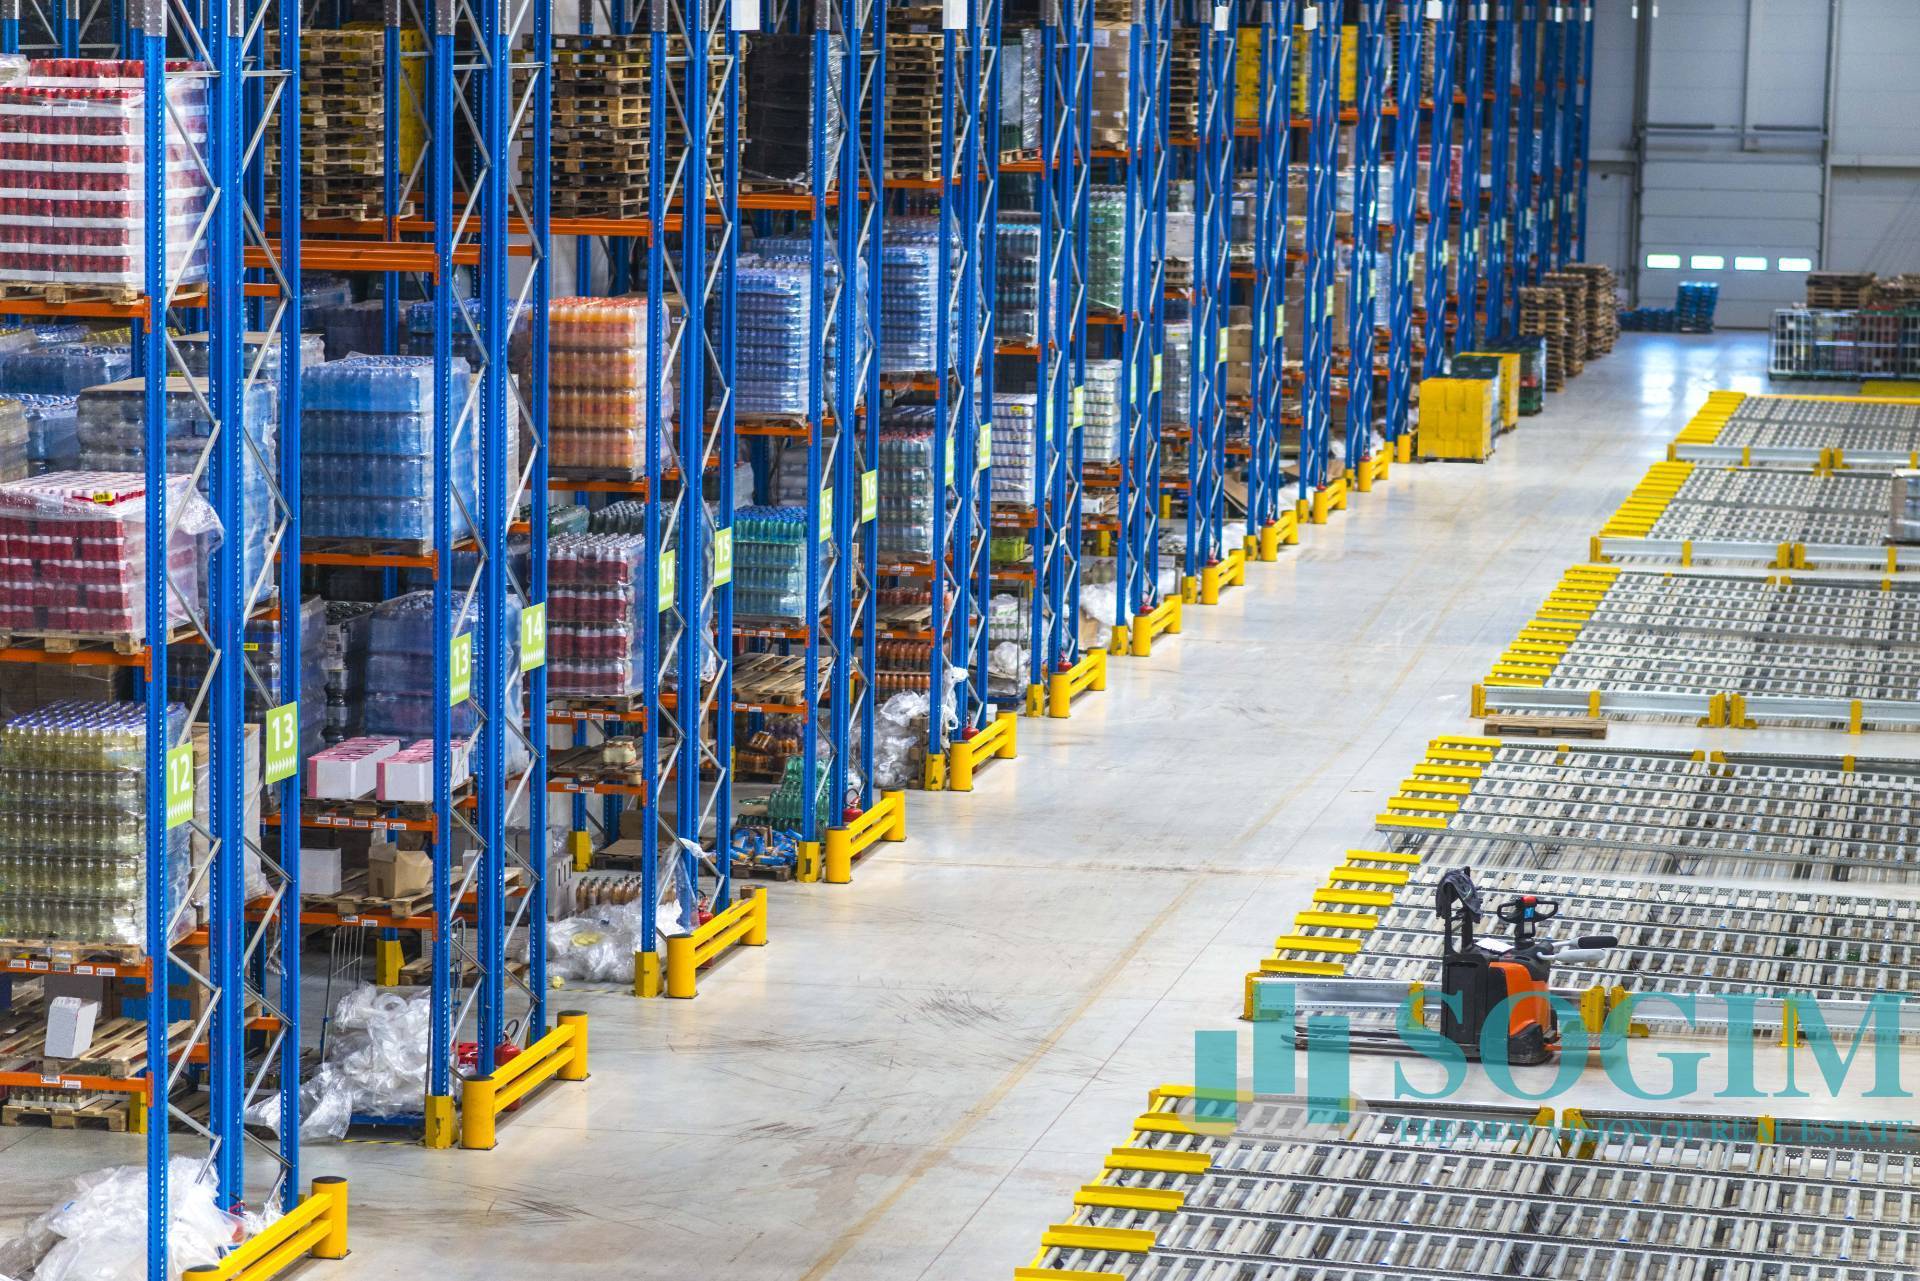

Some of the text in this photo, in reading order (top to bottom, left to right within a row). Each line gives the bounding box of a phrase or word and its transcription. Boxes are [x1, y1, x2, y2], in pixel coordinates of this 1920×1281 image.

[864, 474, 875, 502] 16
[822, 494, 831, 521] 15
[718, 534, 730, 563] 15
[661, 557, 673, 587] 14
[525, 611, 544, 645] 14
[453, 641, 469, 681] 13
[272, 712, 294, 752] 13
[170, 753, 190, 795] 12
